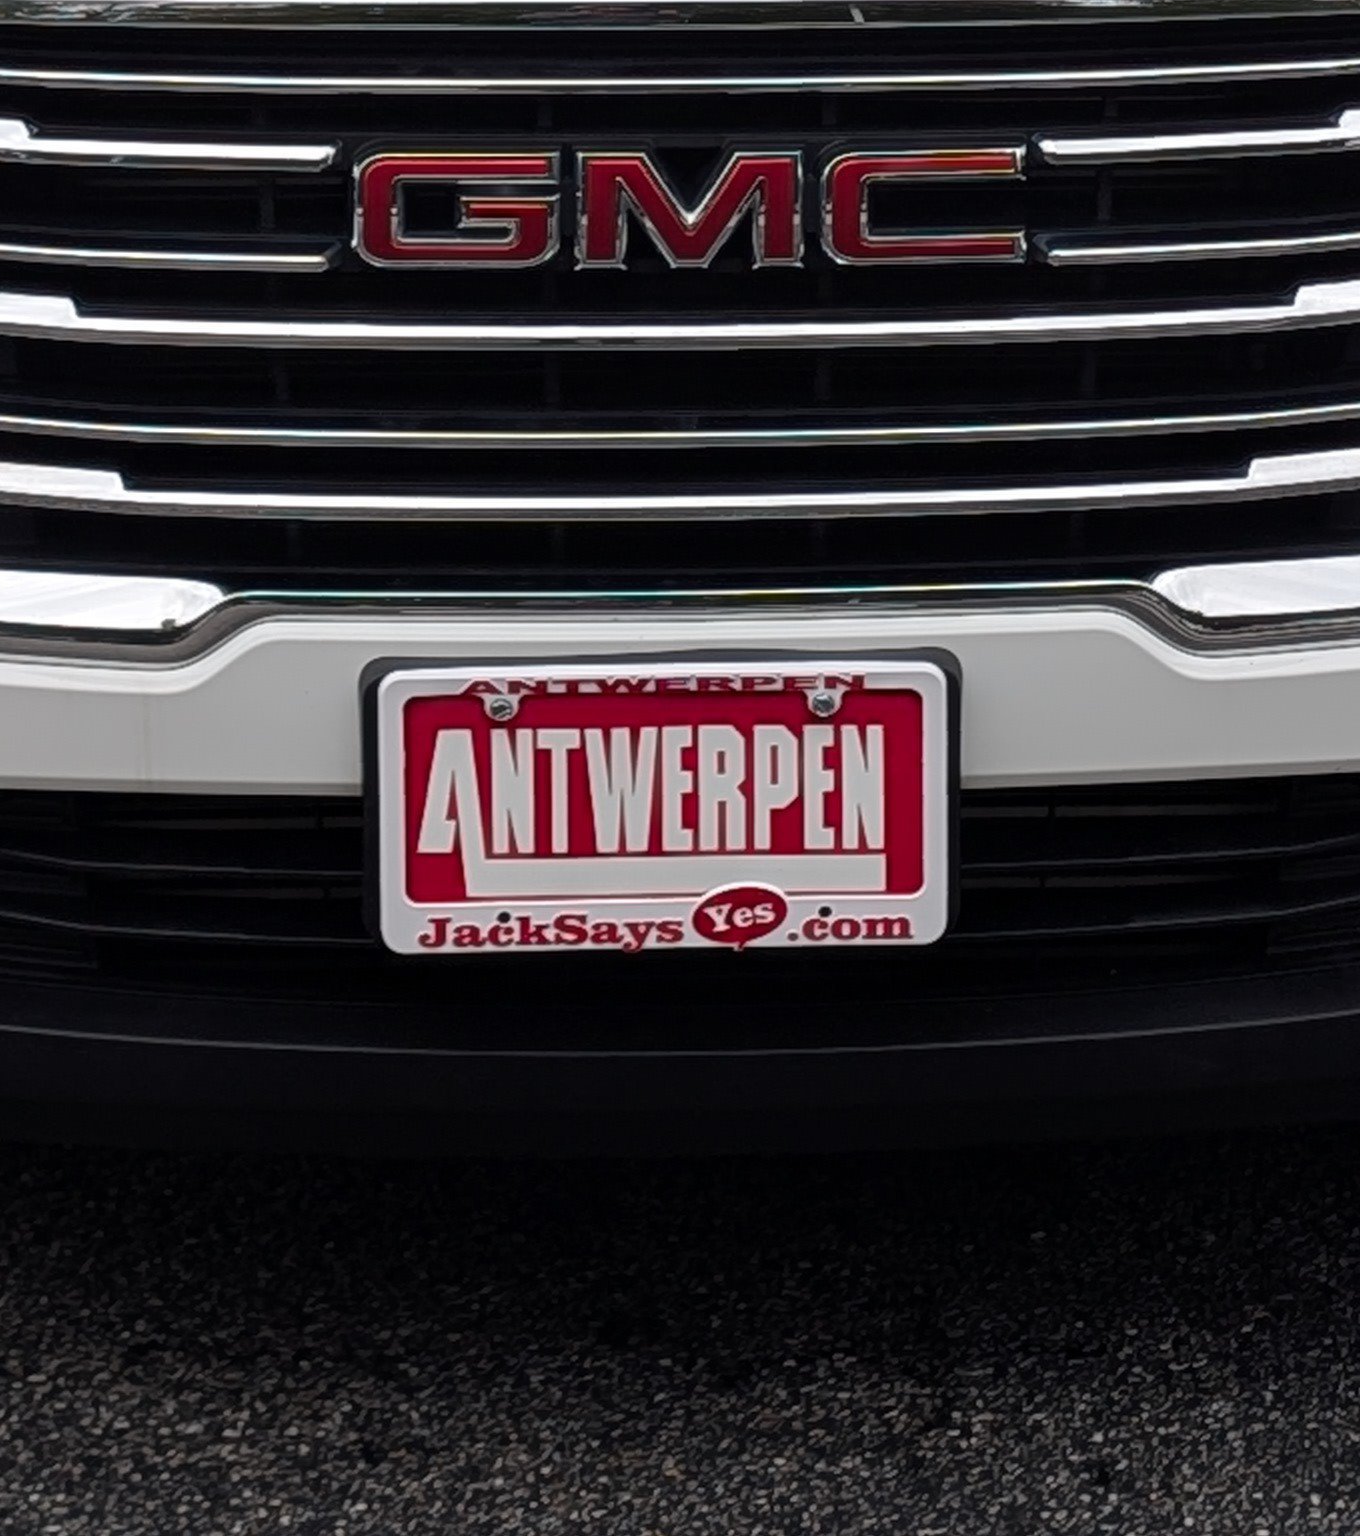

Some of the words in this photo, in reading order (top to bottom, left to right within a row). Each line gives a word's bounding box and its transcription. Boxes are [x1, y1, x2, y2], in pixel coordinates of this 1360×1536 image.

[351, 149, 1027, 271] GMC
[460, 674, 866, 696] ANTWERPEN
[416, 723, 886, 855] ANTWERPEN
[417, 910, 685, 953] JackSays
[704, 899, 776, 932] Yes
[787, 911, 913, 942] .com
